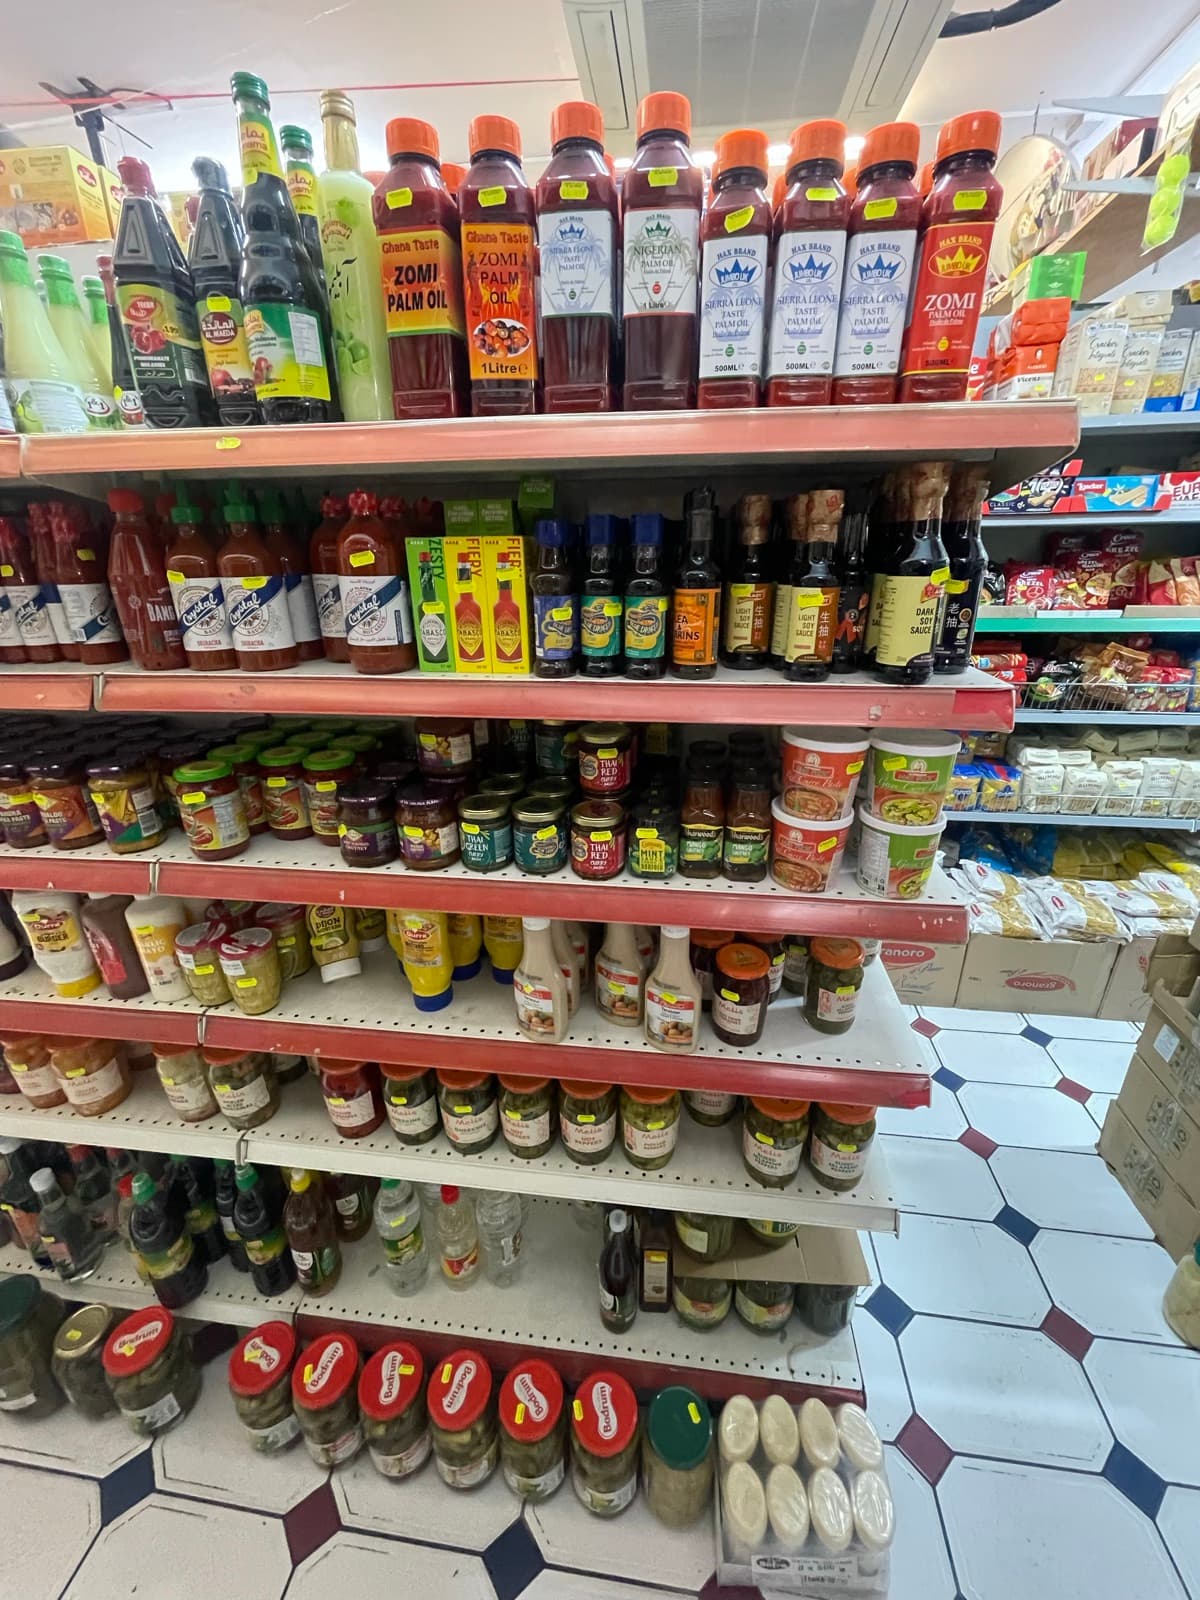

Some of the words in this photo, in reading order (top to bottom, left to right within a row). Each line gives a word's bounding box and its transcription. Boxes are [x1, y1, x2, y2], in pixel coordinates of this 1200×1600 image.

[466, 231, 498, 243] Ghana
[500, 231, 529, 243] Taste
[938, 237, 957, 249] MAX
[957, 235, 983, 246] BRAND
[382, 241, 411, 255] Ghana
[413, 239, 446, 253] Taste
[633, 244, 682, 257] NIGERIAN
[791, 243, 807, 254] MAX
[808, 242, 832, 253] BRAND
[860, 245, 876, 256] MAX
[877, 243, 901, 253] BRAND
[478, 251, 519, 267] ZOMI
[717, 247, 732, 260] MAX
[734, 247, 757, 257] BRAND
[394, 263, 438, 286] ZOMI
[480, 271, 519, 285] PALM
[387, 293, 424, 313] PALM
[426, 290, 449, 309] OIL
[489, 291, 512, 305] OIL
[705, 298, 734, 310] SIERRA
[735, 297, 762, 307] LEONE
[777, 296, 807, 305] SIERRA
[809, 295, 837, 304] LEONE
[844, 295, 874, 306] SIERRA
[923, 293, 976, 312] ZOMI
[722, 310, 745, 319] TASTE
[795, 306, 818, 315] TASTE
[862, 306, 886, 316] TASTE
[928, 310, 952, 320] PALM
[952, 309, 966, 319] OIL
[715, 321, 735, 329] PALM
[787, 317, 808, 326] PALM
[854, 317, 876, 326] PALM
[714, 364, 738, 372] 500ML
[786, 362, 810, 370] 500ML
[851, 363, 876, 371] 500ML
[428, 538, 446, 580] ZESTY
[466, 538, 483, 577] FIERY
[182, 593, 218, 626] Crystal
[229, 593, 260, 624] Crystal
[347, 598, 380, 626] Crystal
[915, 608, 935, 616] DARK
[919, 617, 933, 626] SOY
[796, 629, 814, 637] SAUCE
[910, 626, 932, 634] SAUCE
[600, 760, 618, 768] THAI
[600, 768, 618, 776] RED
[467, 835, 484, 843] THAI
[465, 842, 489, 851] GREEN
[590, 843, 609, 852] THAI
[590, 852, 608, 860] RED
[641, 849, 663, 857] MINT
[315, 918, 340, 930] DIJON
[1013, 980, 1058, 990] granoro
[118, 1327, 160, 1350] Bodrum
[309, 1346, 342, 1388] Bodrum
[383, 1355, 400, 1400] Bodrum
[445, 1365, 473, 1409] Bodrum
[519, 1376, 545, 1418] Bodrum
